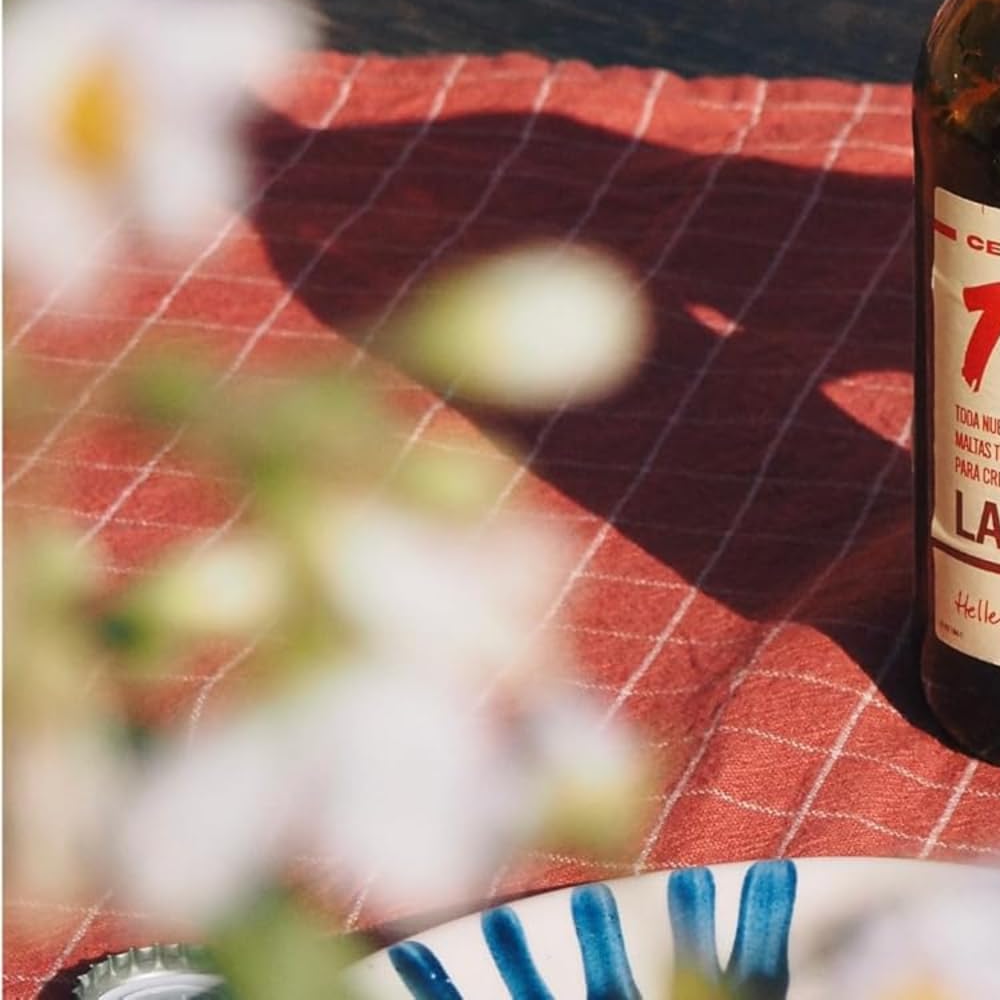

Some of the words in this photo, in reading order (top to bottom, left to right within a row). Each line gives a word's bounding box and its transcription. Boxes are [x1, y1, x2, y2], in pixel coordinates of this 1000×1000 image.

[955, 404, 979, 429] TODA
[955, 431, 991, 458] MALTAS
[955, 457, 980, 482] PARA
